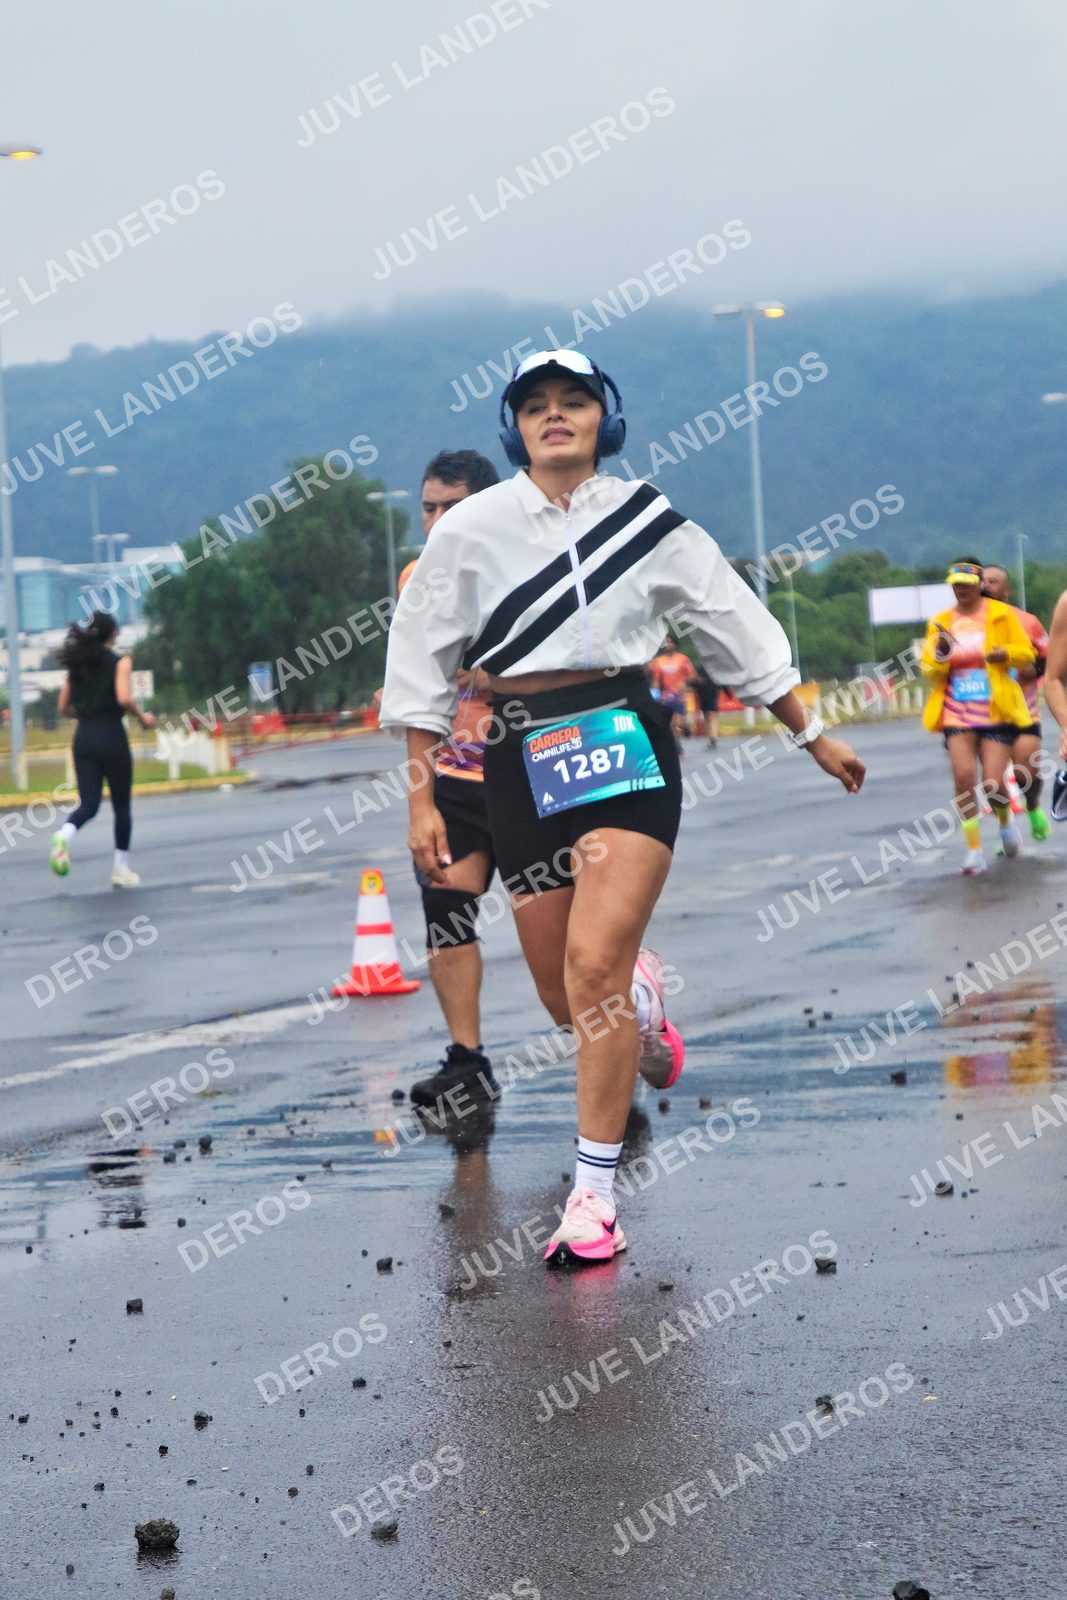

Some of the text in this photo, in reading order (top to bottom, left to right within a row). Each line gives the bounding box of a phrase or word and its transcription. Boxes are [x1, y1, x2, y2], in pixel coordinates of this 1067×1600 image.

[613, 714, 636, 733] 10K
[529, 725, 580, 753] CARRERA
[553, 743, 627, 784] 1287
